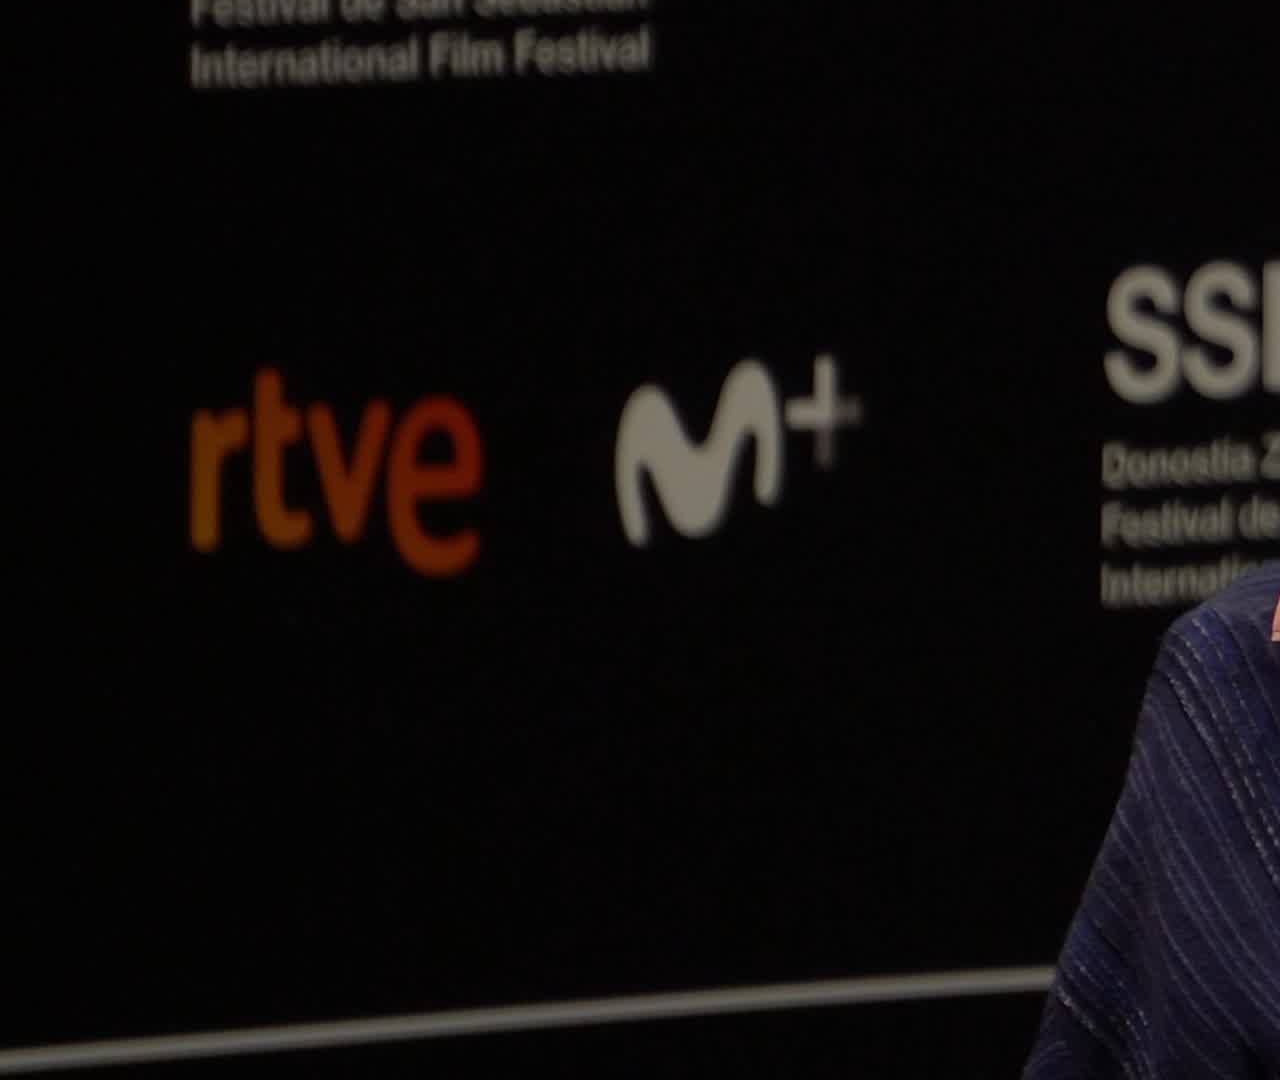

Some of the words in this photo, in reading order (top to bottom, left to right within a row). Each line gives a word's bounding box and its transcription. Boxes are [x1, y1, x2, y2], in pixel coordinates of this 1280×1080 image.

[191, 32, 422, 88] International
[428, 28, 505, 78] Film
[513, 21, 651, 75] Festival
[189, 367, 484, 577] rtve
[1102, 435, 1258, 491] Donostia
[1102, 497, 1233, 550] Festival
